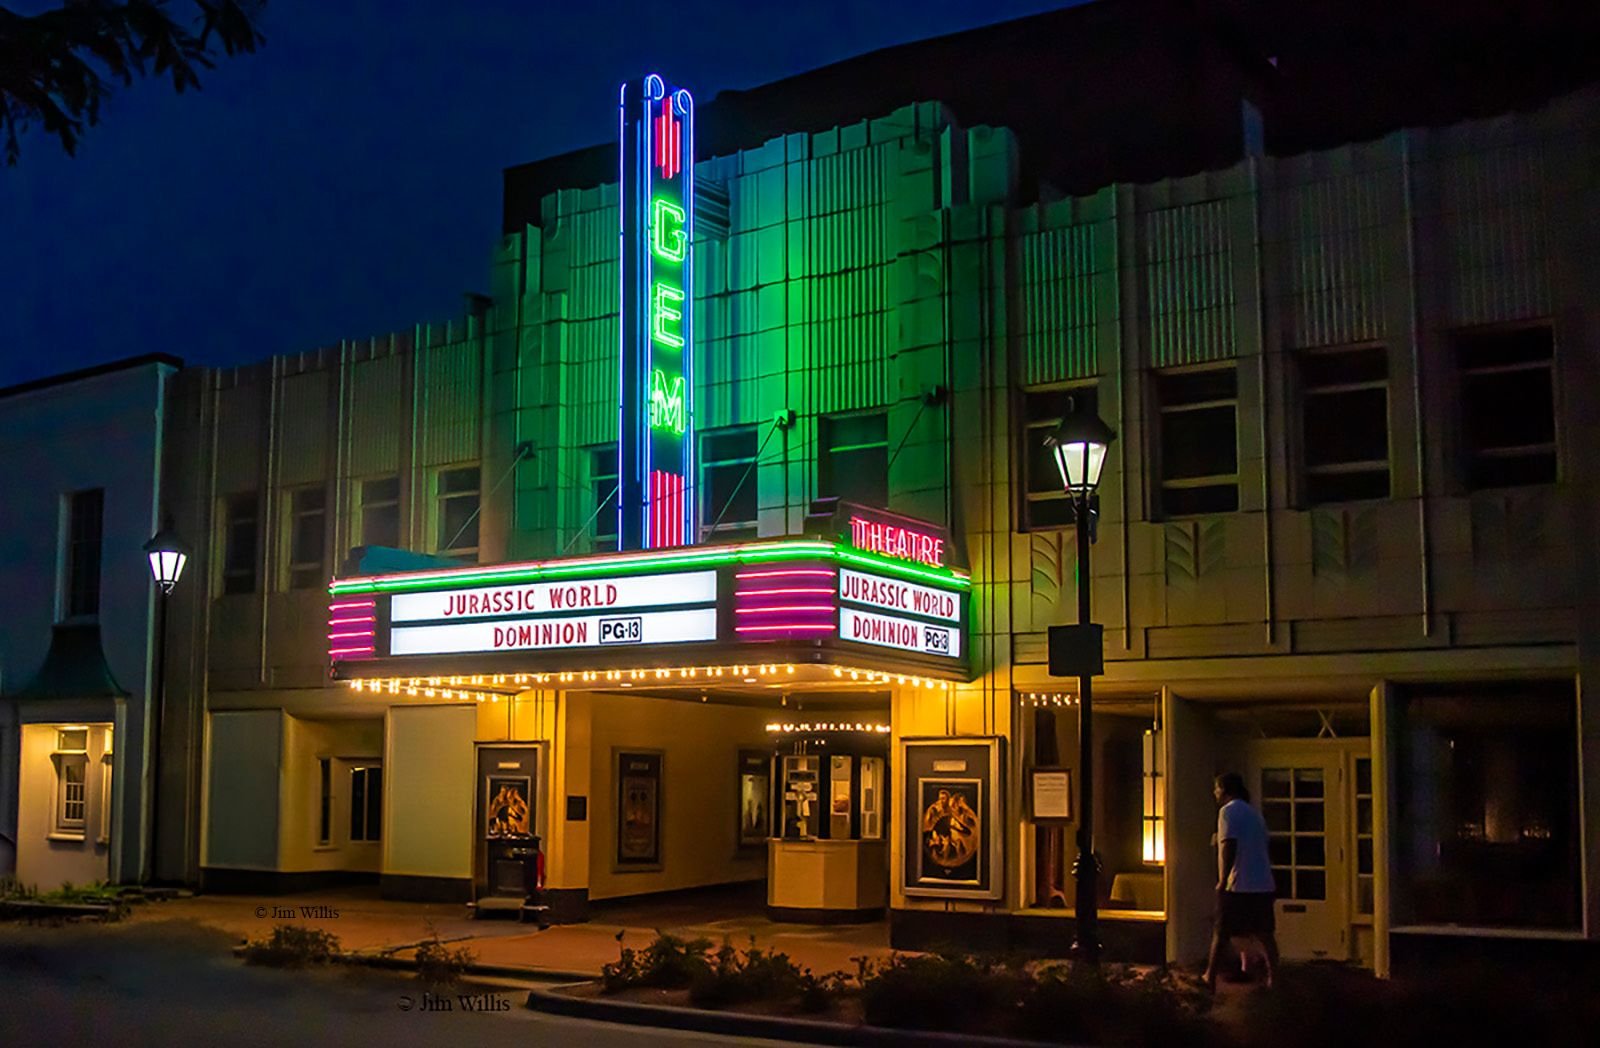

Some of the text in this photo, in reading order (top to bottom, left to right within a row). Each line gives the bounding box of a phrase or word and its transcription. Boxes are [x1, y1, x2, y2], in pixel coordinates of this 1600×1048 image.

[650, 198, 686, 434] GEM
[851, 515, 945, 568] THEATRE
[443, 584, 618, 616] JURASSIC WORLD
[842, 575, 954, 618] JURASSIC WORLD
[493, 621, 588, 648] DOMINION
[853, 615, 918, 648] DOMINION
